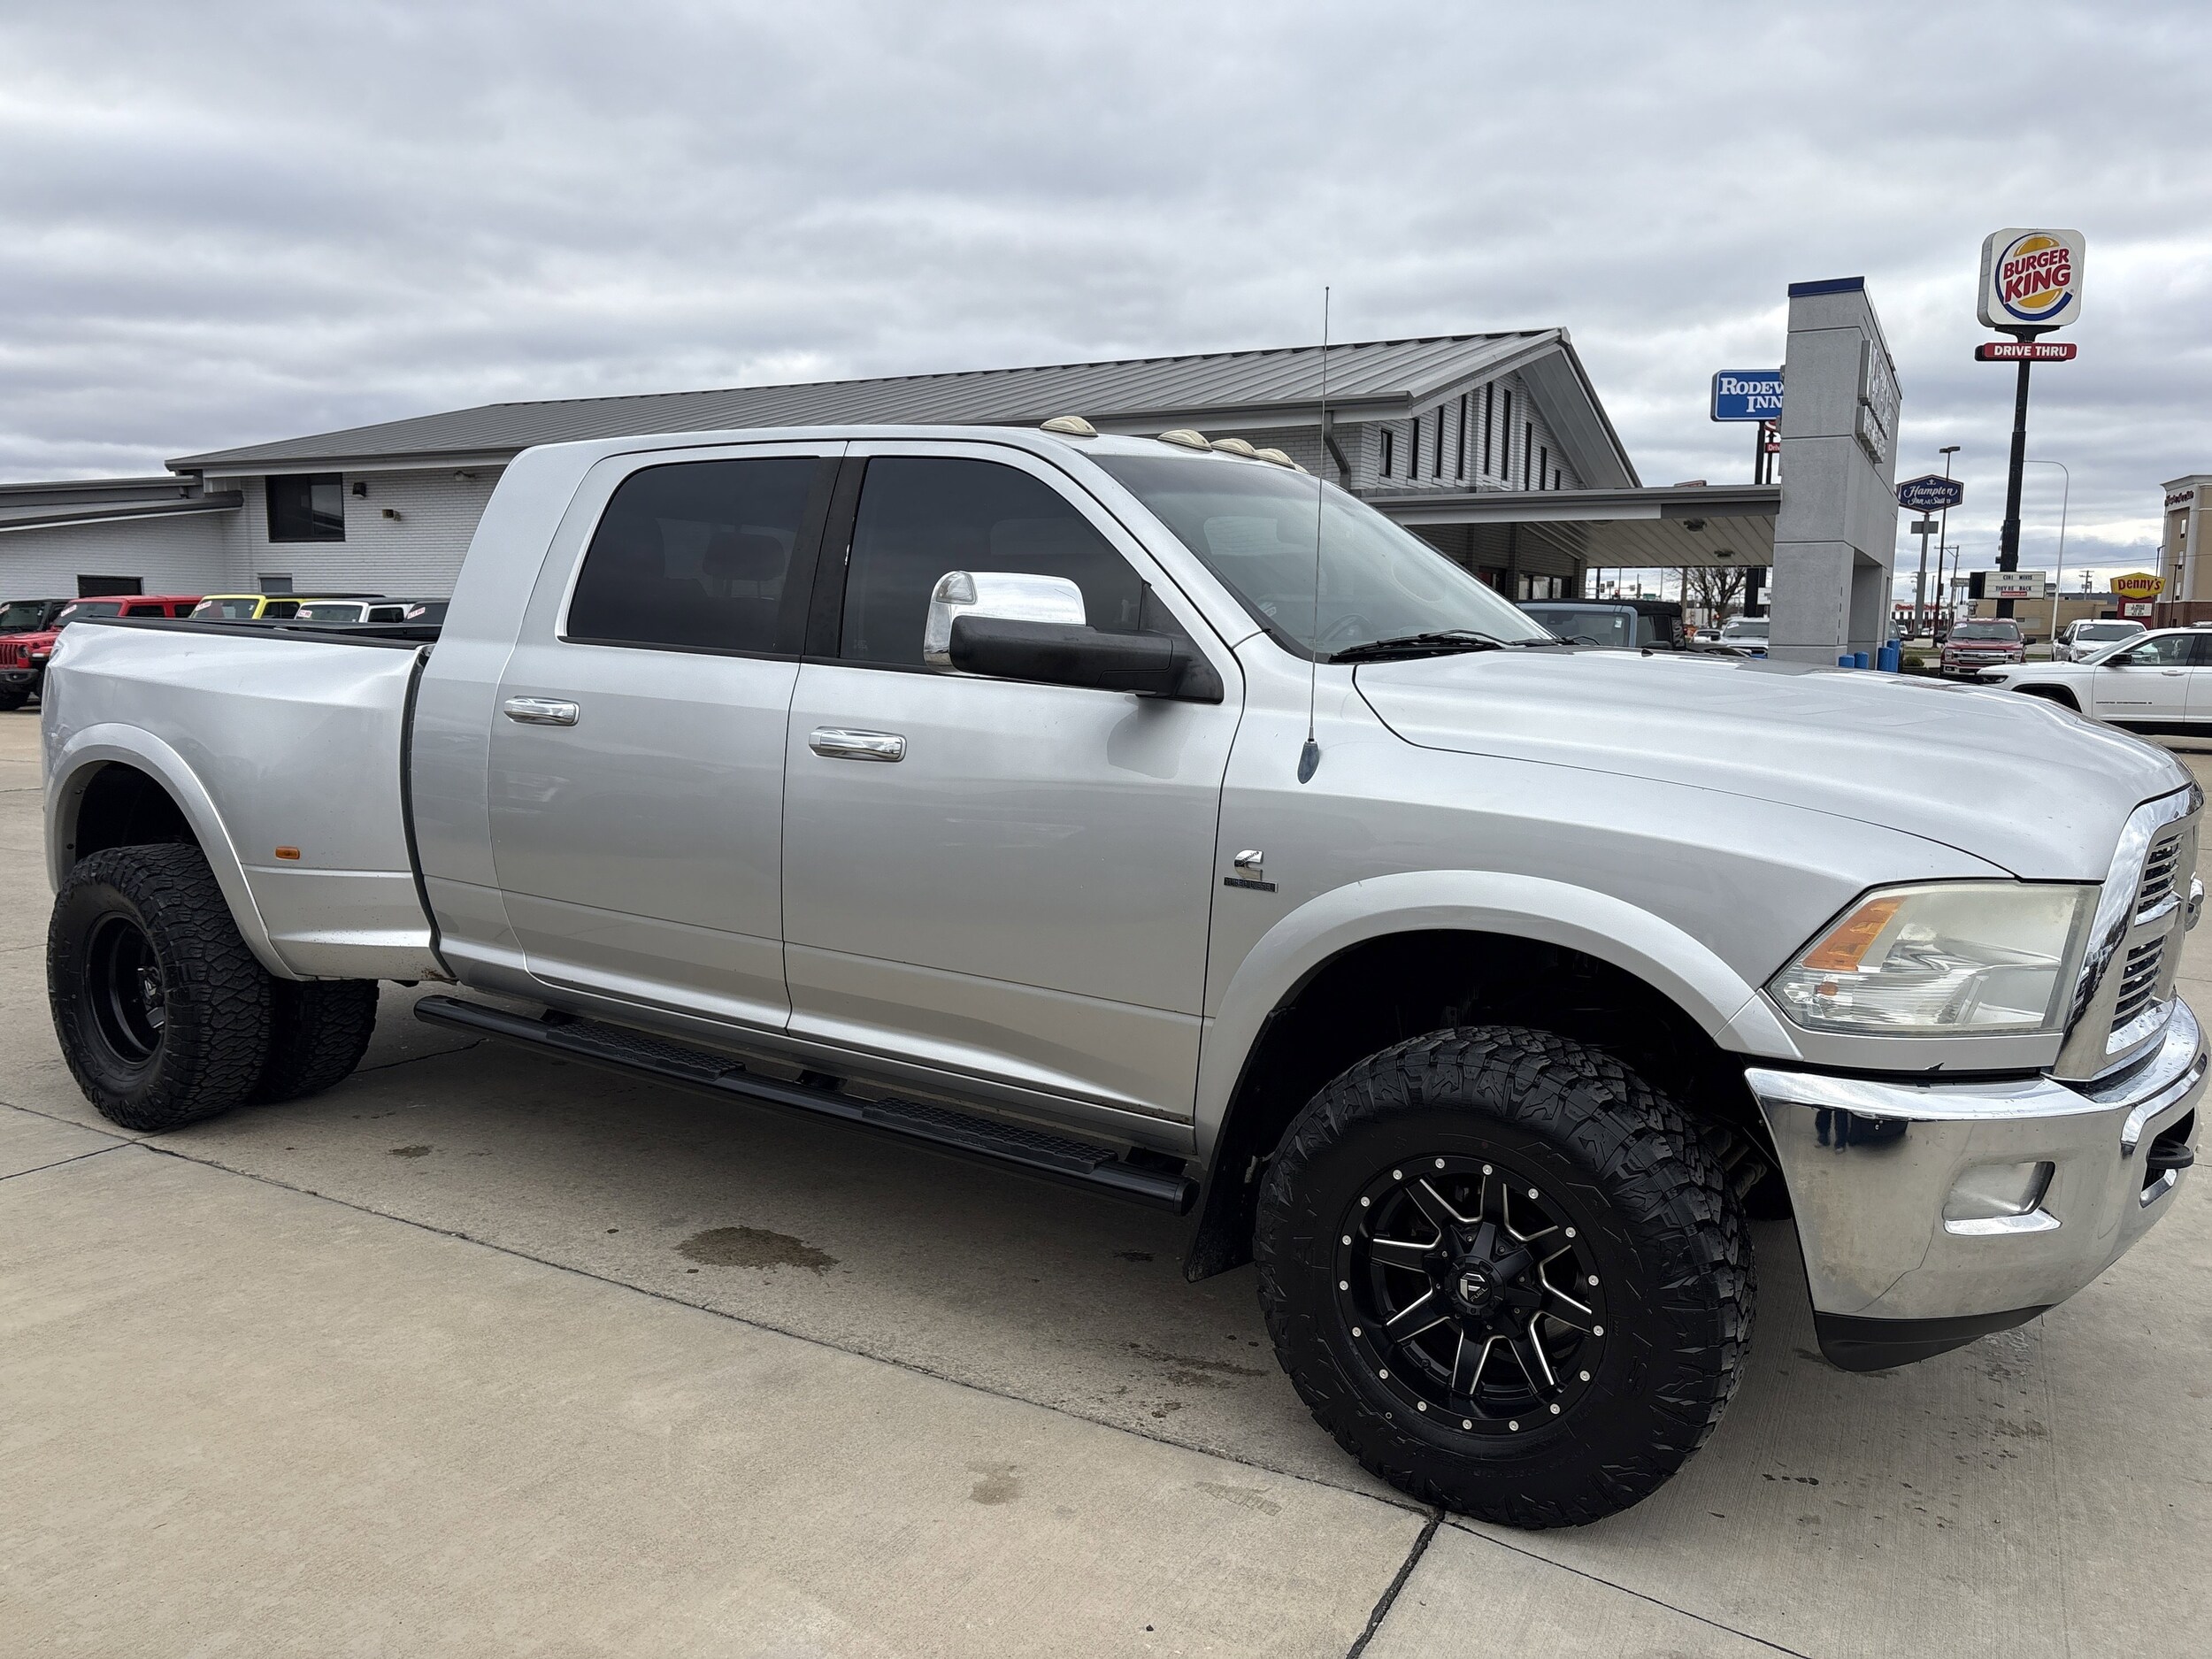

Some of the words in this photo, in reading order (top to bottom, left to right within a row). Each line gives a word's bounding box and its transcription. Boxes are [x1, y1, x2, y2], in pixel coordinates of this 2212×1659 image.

[2003, 249, 2070, 280] BURGER
[2004, 264, 2071, 303] KING
[1994, 345, 2032, 357] DRIVE
[2035, 346, 2067, 357] THRU
[1747, 396, 1784, 412] INN
[1903, 485, 1958, 498] Hampton
[2118, 579, 2162, 591] Denny's
[1470, 1287, 1488, 1302] FUEL
